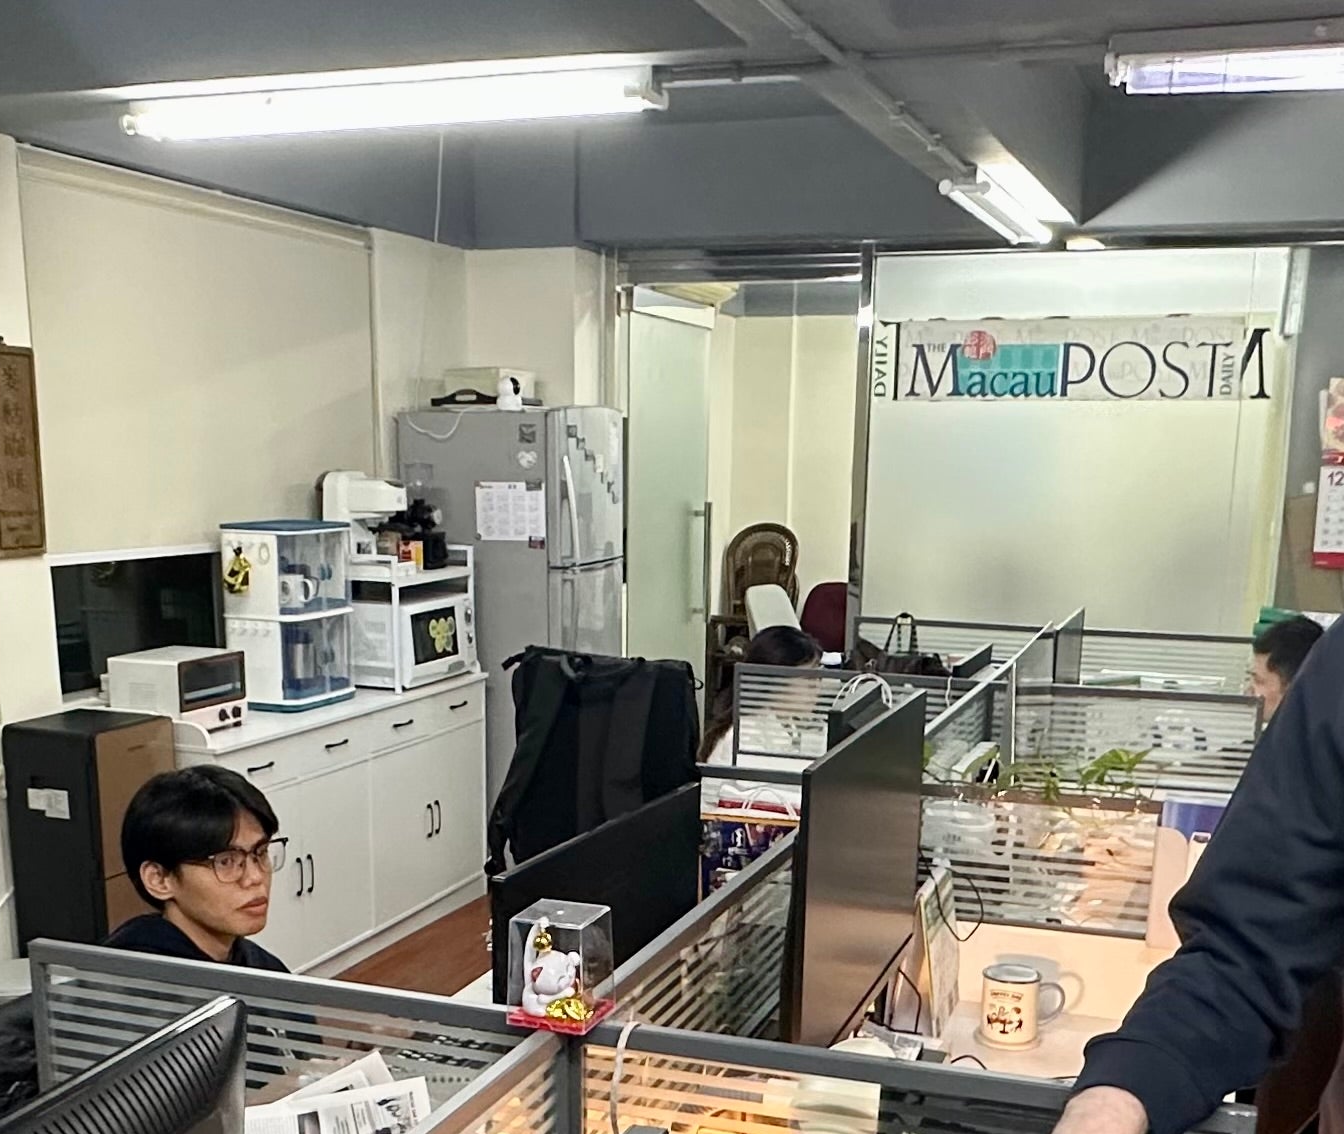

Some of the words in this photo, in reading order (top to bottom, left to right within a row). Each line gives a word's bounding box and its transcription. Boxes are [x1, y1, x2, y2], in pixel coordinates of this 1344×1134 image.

[927, 343, 946, 353] THE
[1219, 352, 1235, 396] DAILY
[1327, 471, 1344, 486] 12
